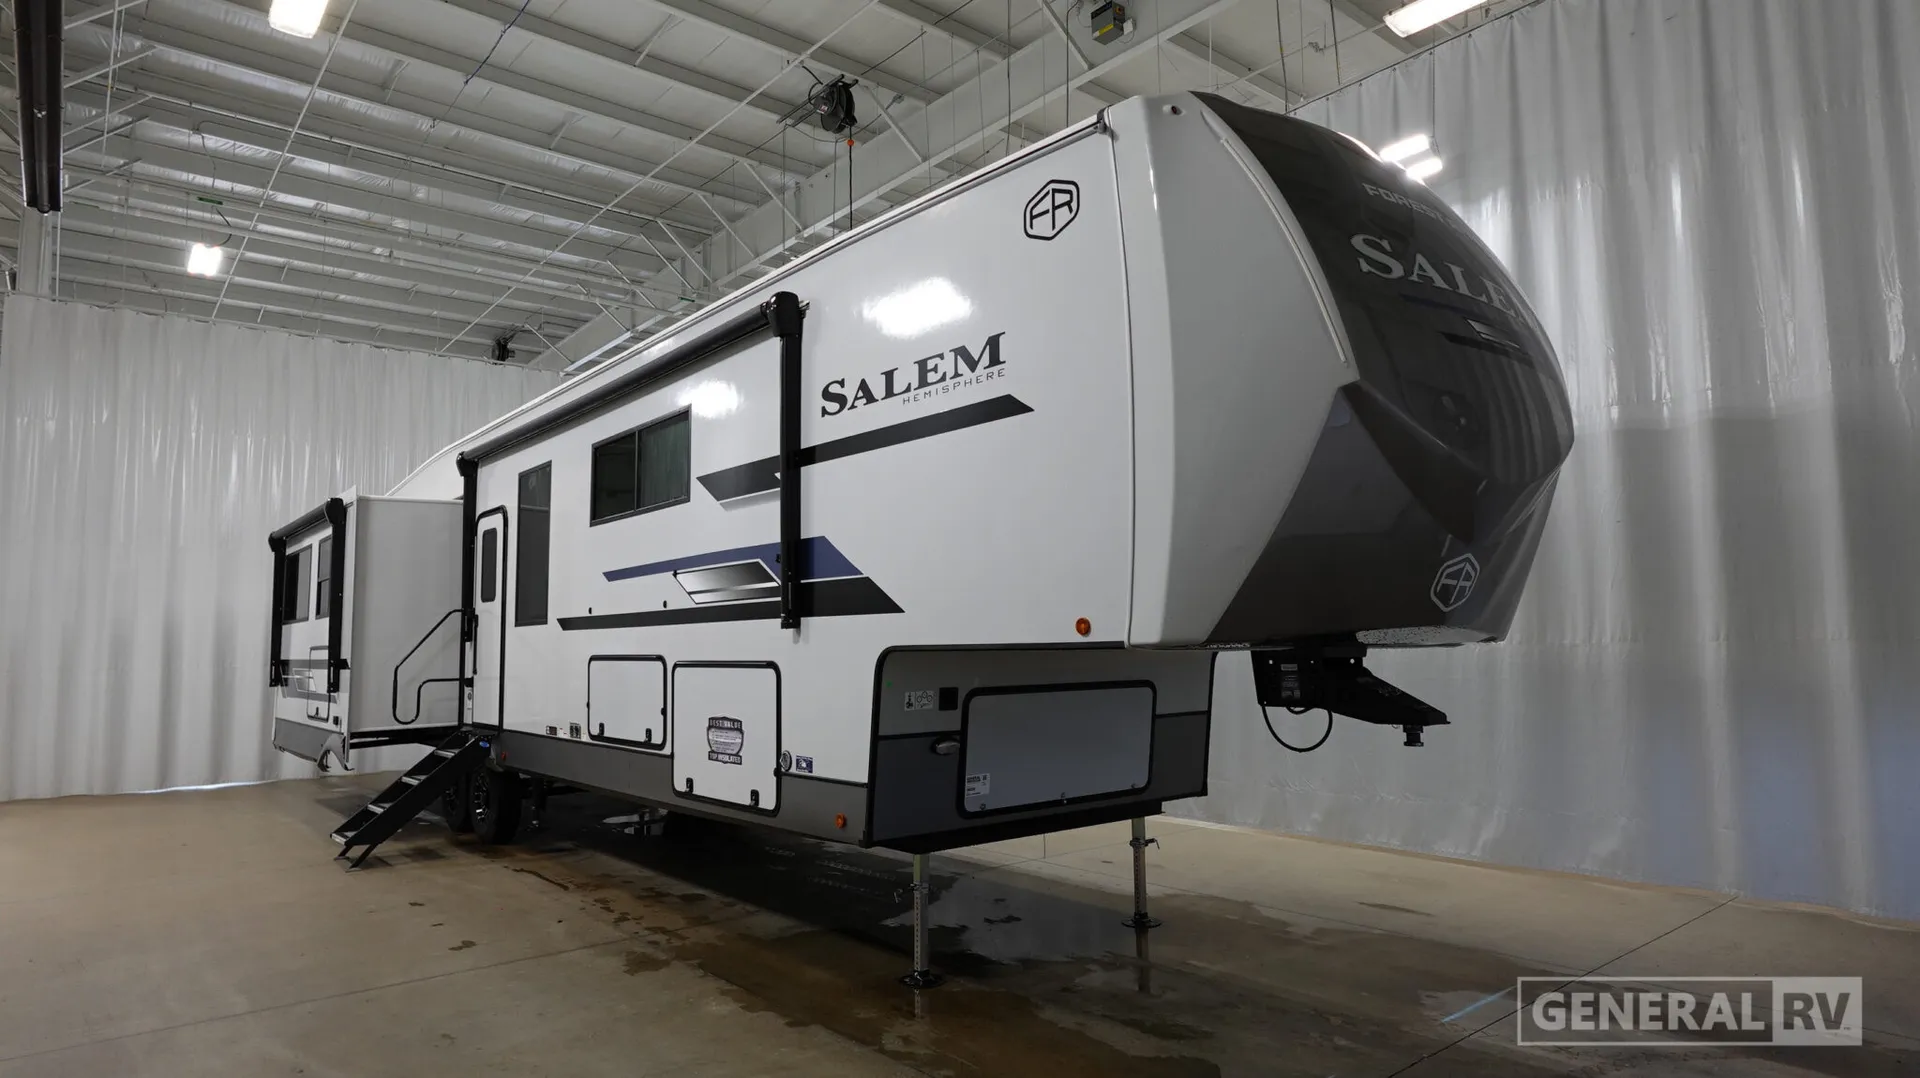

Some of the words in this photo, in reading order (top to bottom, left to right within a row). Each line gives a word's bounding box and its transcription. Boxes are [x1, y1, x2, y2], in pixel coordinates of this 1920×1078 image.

[1350, 233, 1534, 327] SALE
[821, 331, 1006, 418] SALEM
[902, 367, 1006, 405] HEMISPHERE
